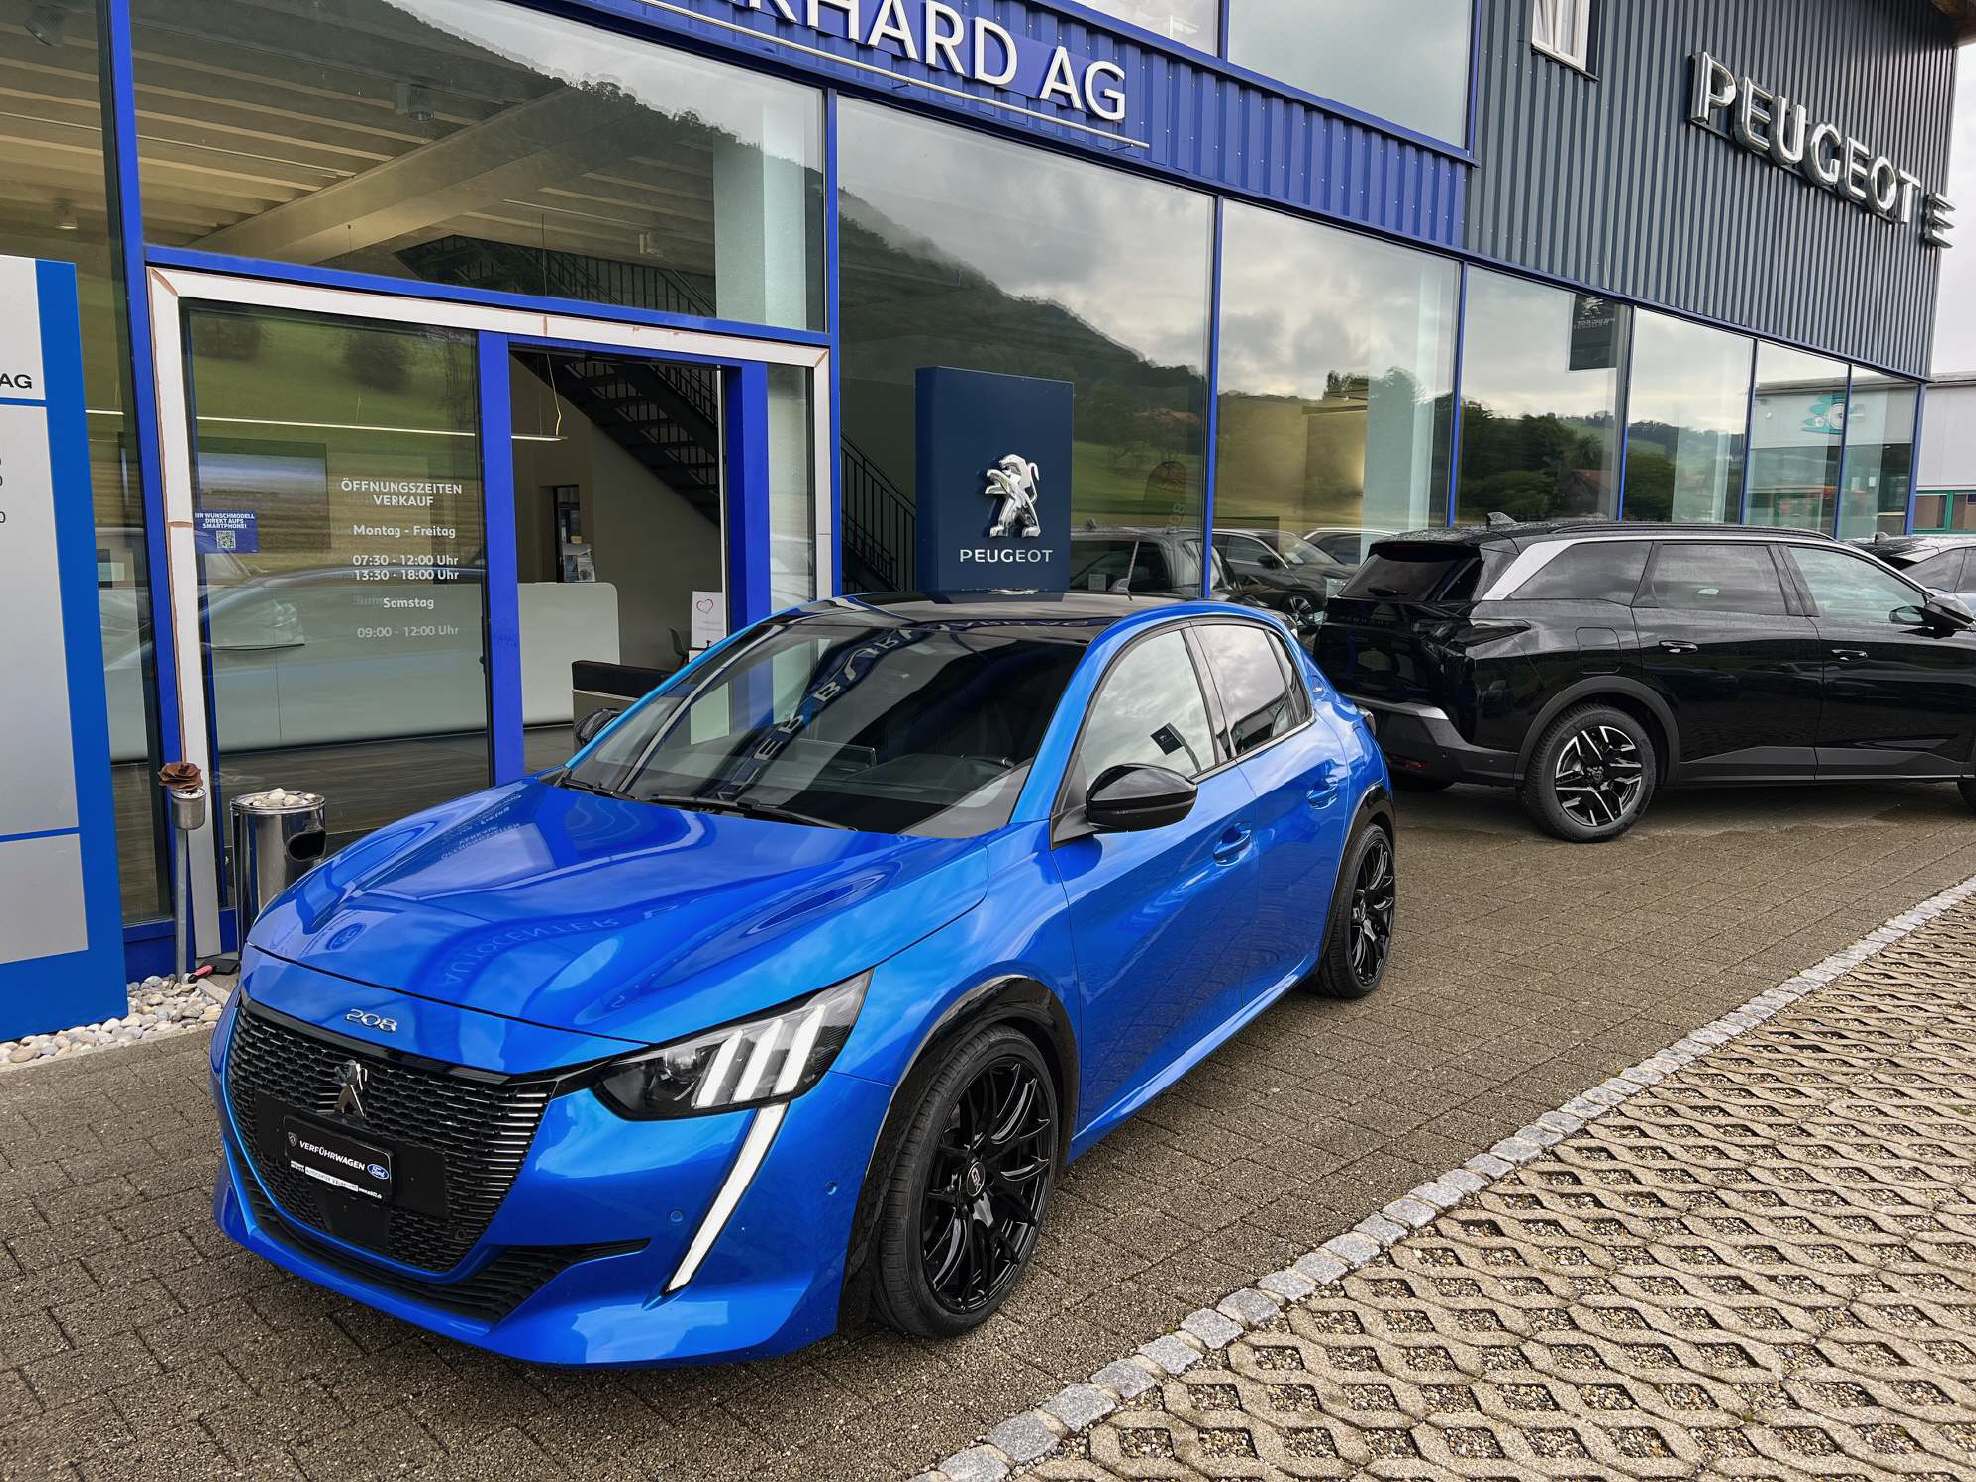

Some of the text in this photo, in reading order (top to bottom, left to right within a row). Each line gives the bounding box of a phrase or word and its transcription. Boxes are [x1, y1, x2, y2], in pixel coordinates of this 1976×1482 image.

[1039, 46, 1126, 121] AG
[1689, 51, 1921, 224] PEUGEOT
[341, 477, 463, 495] ÖFFNUNGSZEITEN
[373, 494, 434, 507] VERKAUF
[353, 525, 401, 538] Montag
[413, 525, 456, 538] Freitag
[352, 554, 389, 566] 07:30
[401, 554, 434, 566] 12:00
[437, 554, 459, 566] Uhr
[959, 549, 1053, 563] PEUGEOT
[354, 569, 390, 581] 13:30
[401, 569, 434, 580] 18:00
[438, 569, 459, 580] Uhr
[383, 597, 434, 610] Samstag
[357, 627, 393, 638] 09:00
[403, 625, 436, 637] 12:00
[438, 625, 459, 636] Uhr
[346, 1008, 397, 1031] 208
[299, 1140, 366, 1171] VERFÜHRWAGEN
